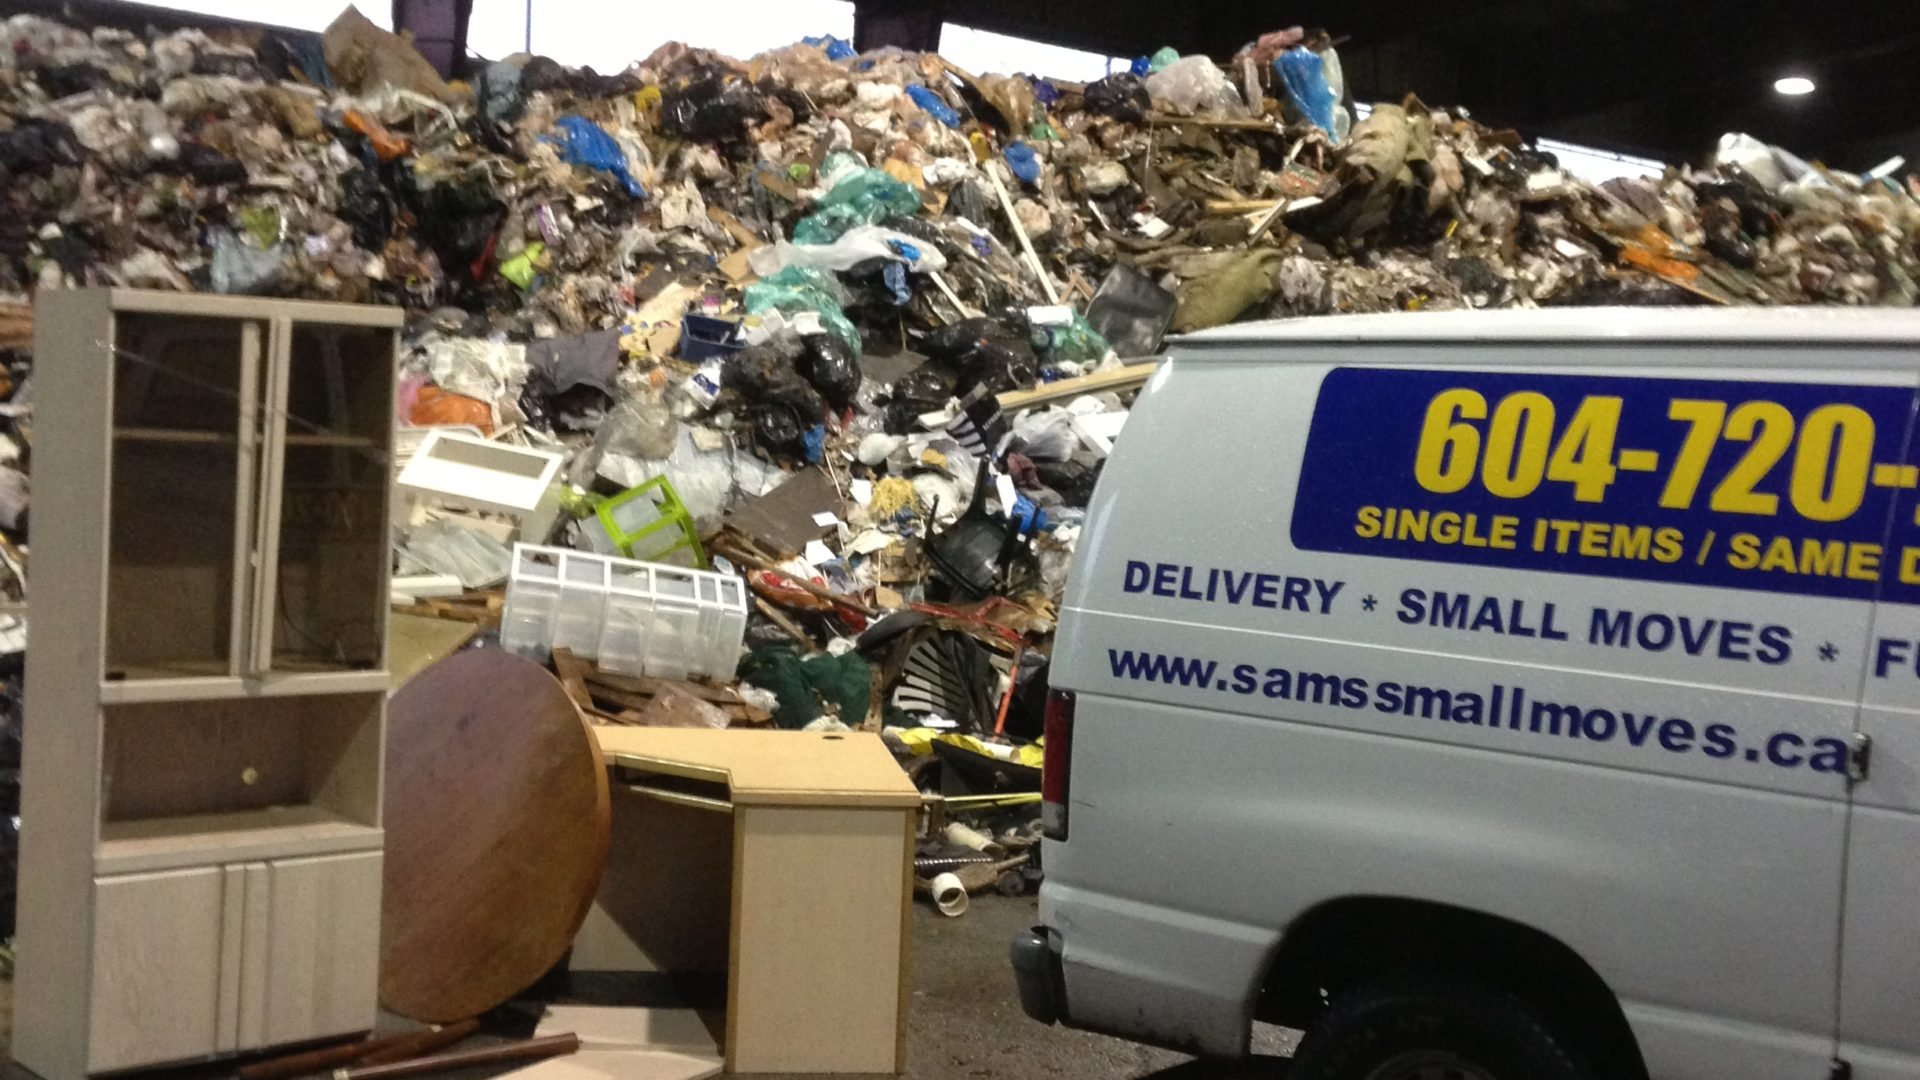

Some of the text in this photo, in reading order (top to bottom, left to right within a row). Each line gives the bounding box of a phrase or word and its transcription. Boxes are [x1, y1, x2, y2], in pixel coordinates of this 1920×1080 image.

[1414, 387, 1920, 526] 604-720-
[1354, 506, 1520, 551] SINGLE
[1533, 519, 1684, 564] ITEMS
[1697, 531, 1715, 566] /
[1727, 533, 1883, 581] SAME
[1123, 560, 1345, 615] DELIVERY
[1396, 588, 1568, 642] SMALL
[1588, 608, 1793, 666] MOVES
[1874, 637, 1920, 681] F
[1108, 648, 1849, 775] www.samssmallmoves.ca
